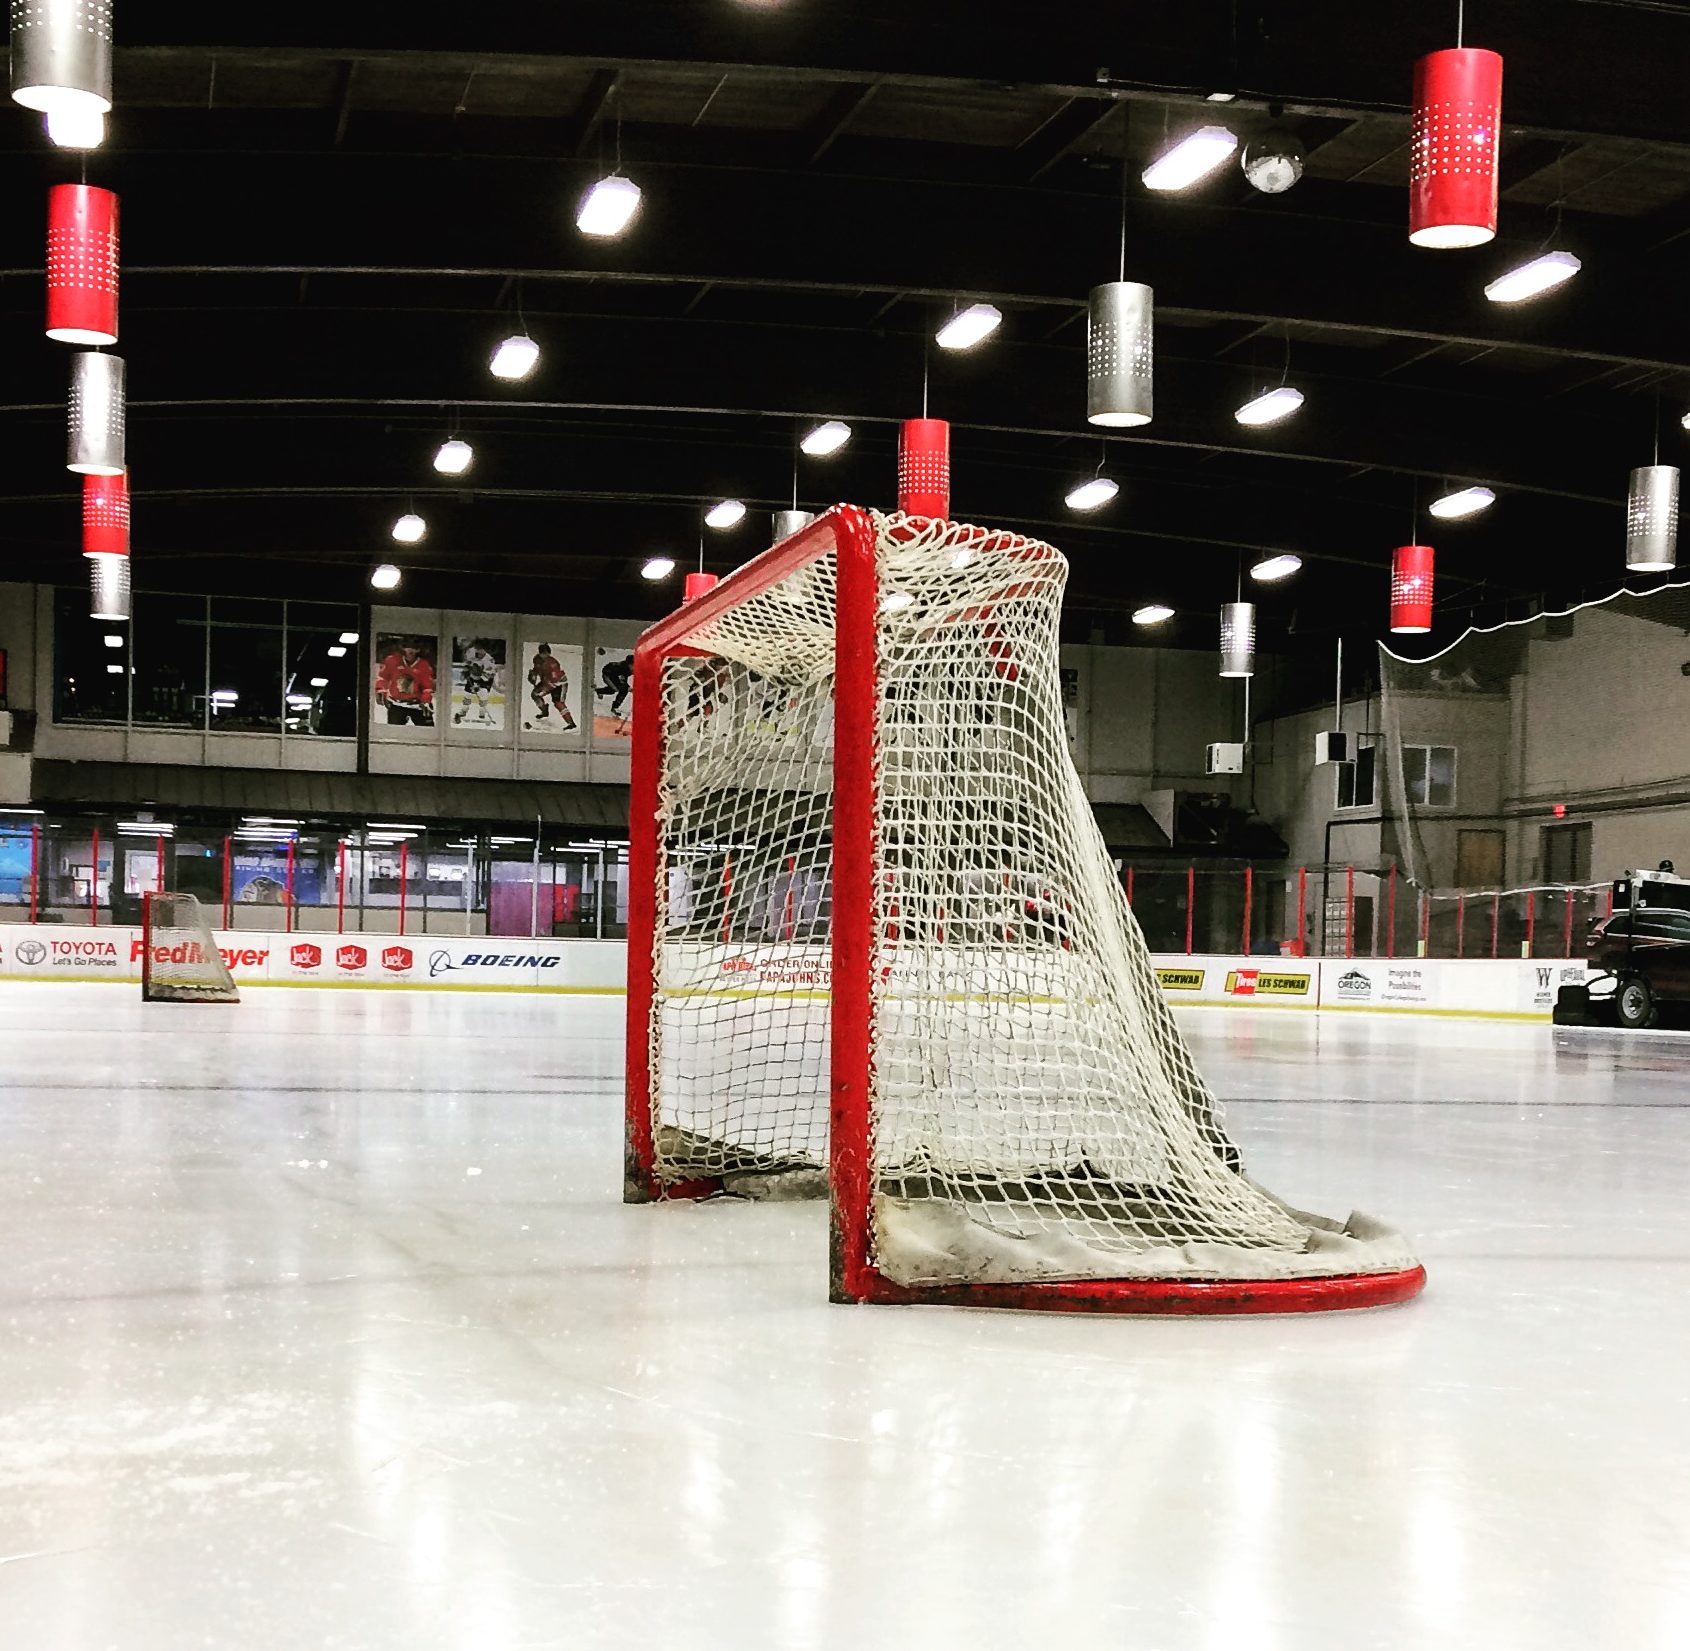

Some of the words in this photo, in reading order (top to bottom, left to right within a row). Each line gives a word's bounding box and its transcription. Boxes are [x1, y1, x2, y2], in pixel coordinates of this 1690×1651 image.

[51, 941, 117, 955] TOYOTA
[88, 958, 117, 966] Places
[461, 954, 561, 968] BOEING
[804, 960, 832, 969] ONLI
[1258, 979, 1271, 988] LES
[1337, 980, 1372, 990] OREGON
